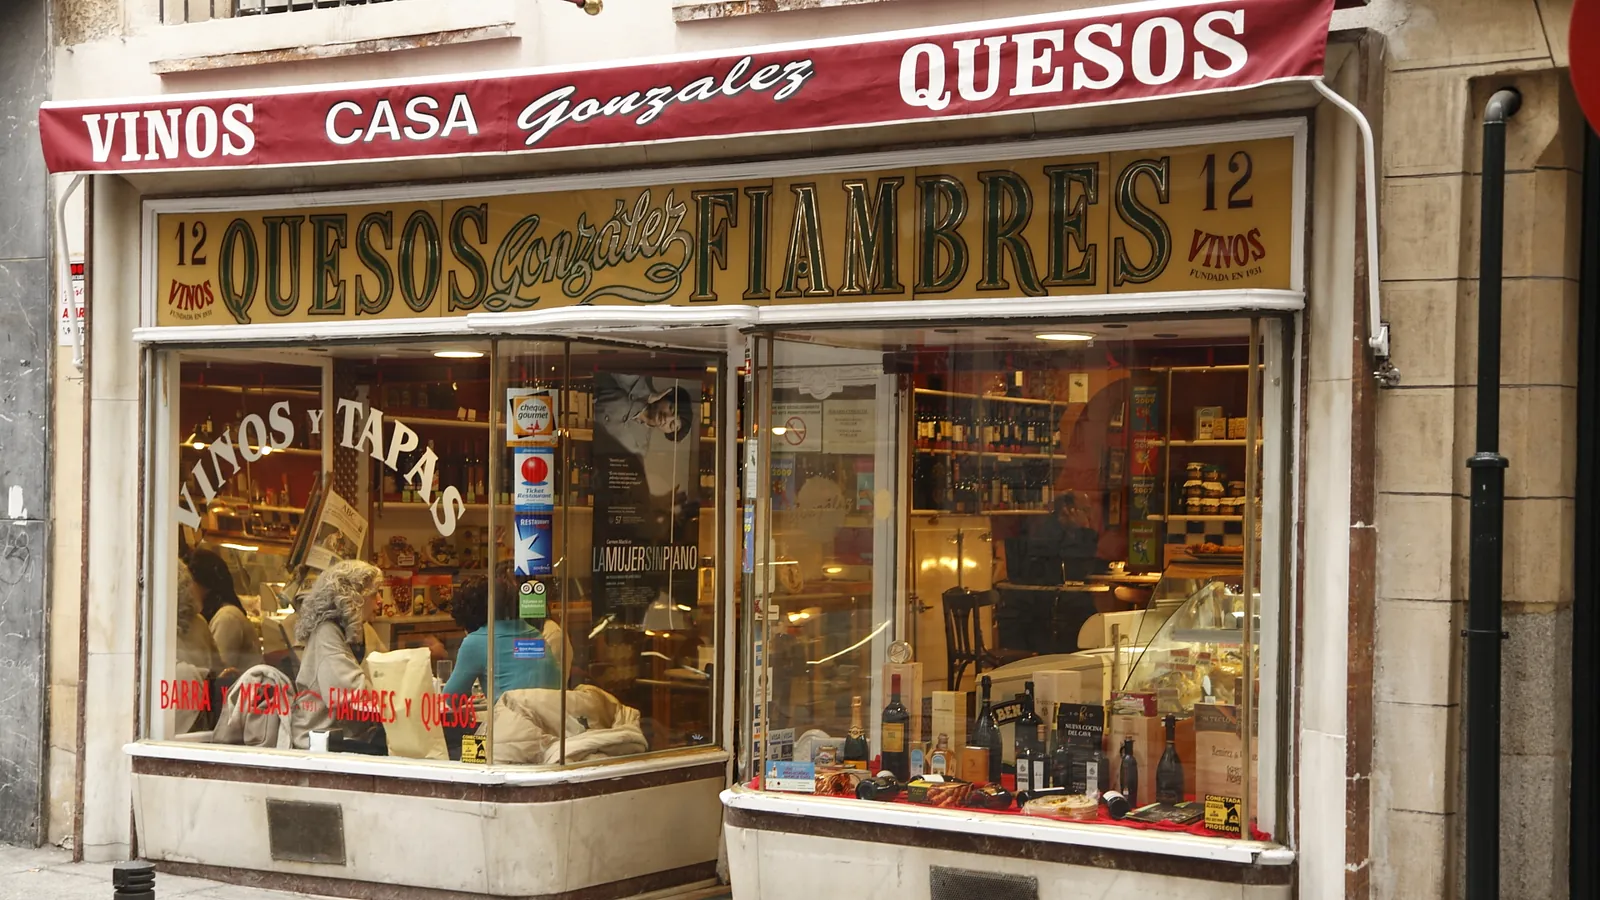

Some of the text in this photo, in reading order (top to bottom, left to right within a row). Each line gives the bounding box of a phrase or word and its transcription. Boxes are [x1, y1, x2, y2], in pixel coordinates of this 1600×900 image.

[899, 9, 1248, 111] QUESOS
[325, 94, 479, 145] CASA
[515, 55, 814, 146] Gonzalez
[82, 103, 256, 163] VINOS
[1198, 150, 1254, 211] 12
[175, 221, 207, 266] 12
[483, 188, 695, 311] González
[690, 156, 1172, 302] FIAMBRES
[1187, 227, 1266, 269] VINOS
[218, 203, 488, 325] QUESOS
[1189, 266, 1262, 282] FUNDADA EN 1931
[168, 278, 215, 311] VINOS
[517, 410, 549, 420] gourmet
[520, 403, 547, 412] cheque
[176, 397, 467, 537] VINOS Y TAPAS
[160, 679, 291, 716] BARRA Y MESAS
[328, 687, 478, 731] FIAMBRES Y QUESOS
[1082, 724, 1103, 732] COCINA
[1205, 794, 1241, 804] CONECTADA
[1205, 823, 1240, 833] PROSEGUR
